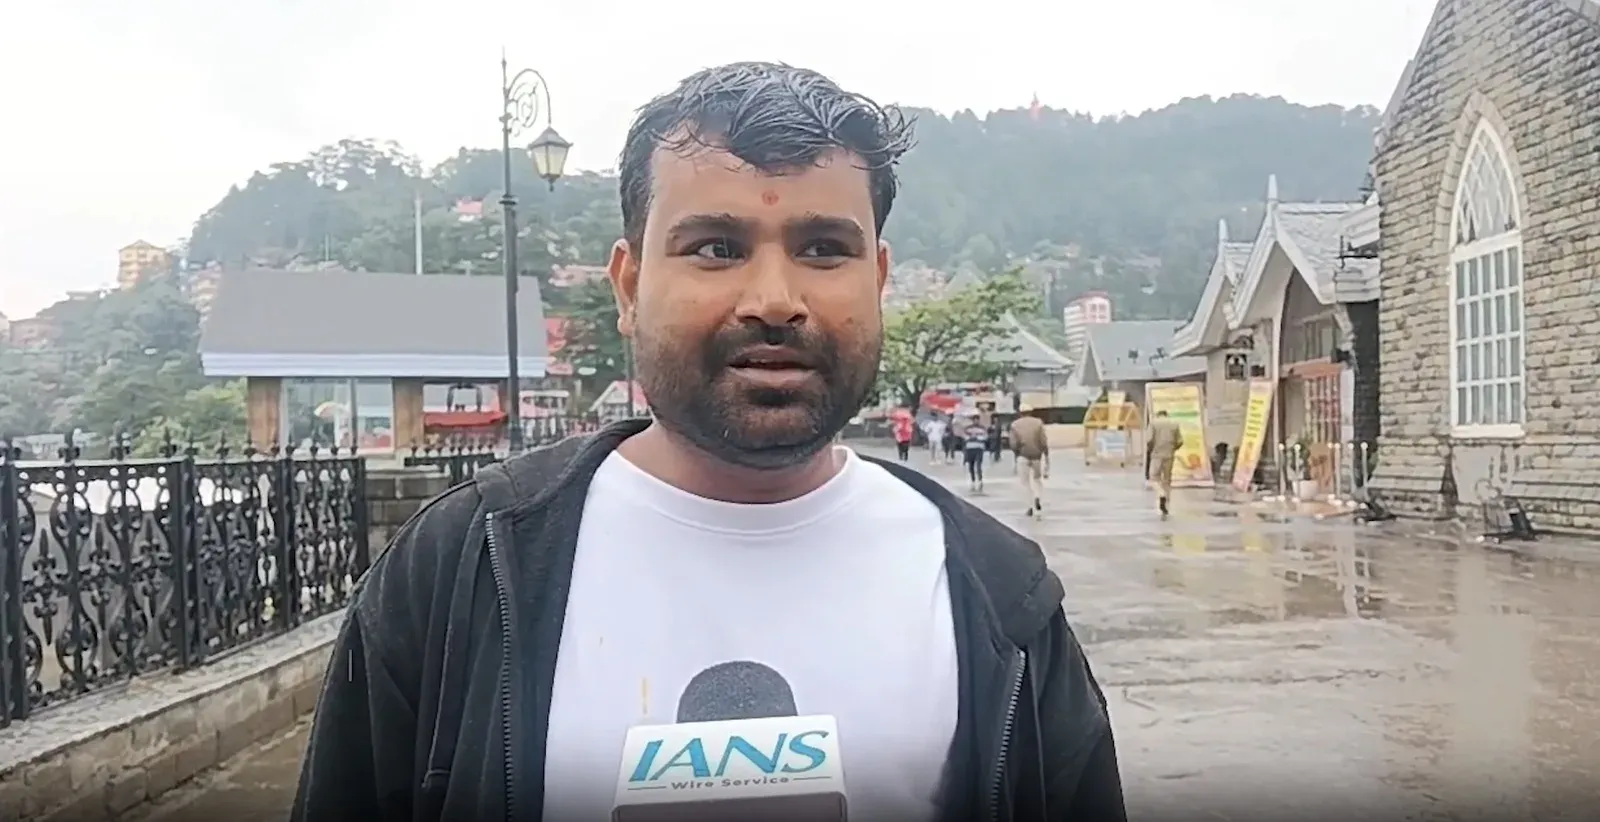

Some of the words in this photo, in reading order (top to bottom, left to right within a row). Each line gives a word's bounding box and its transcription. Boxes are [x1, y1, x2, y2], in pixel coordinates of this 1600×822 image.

[628, 730, 829, 783] IANS
[671, 780, 714, 791] Wire
[721, 776, 790, 787] Service
